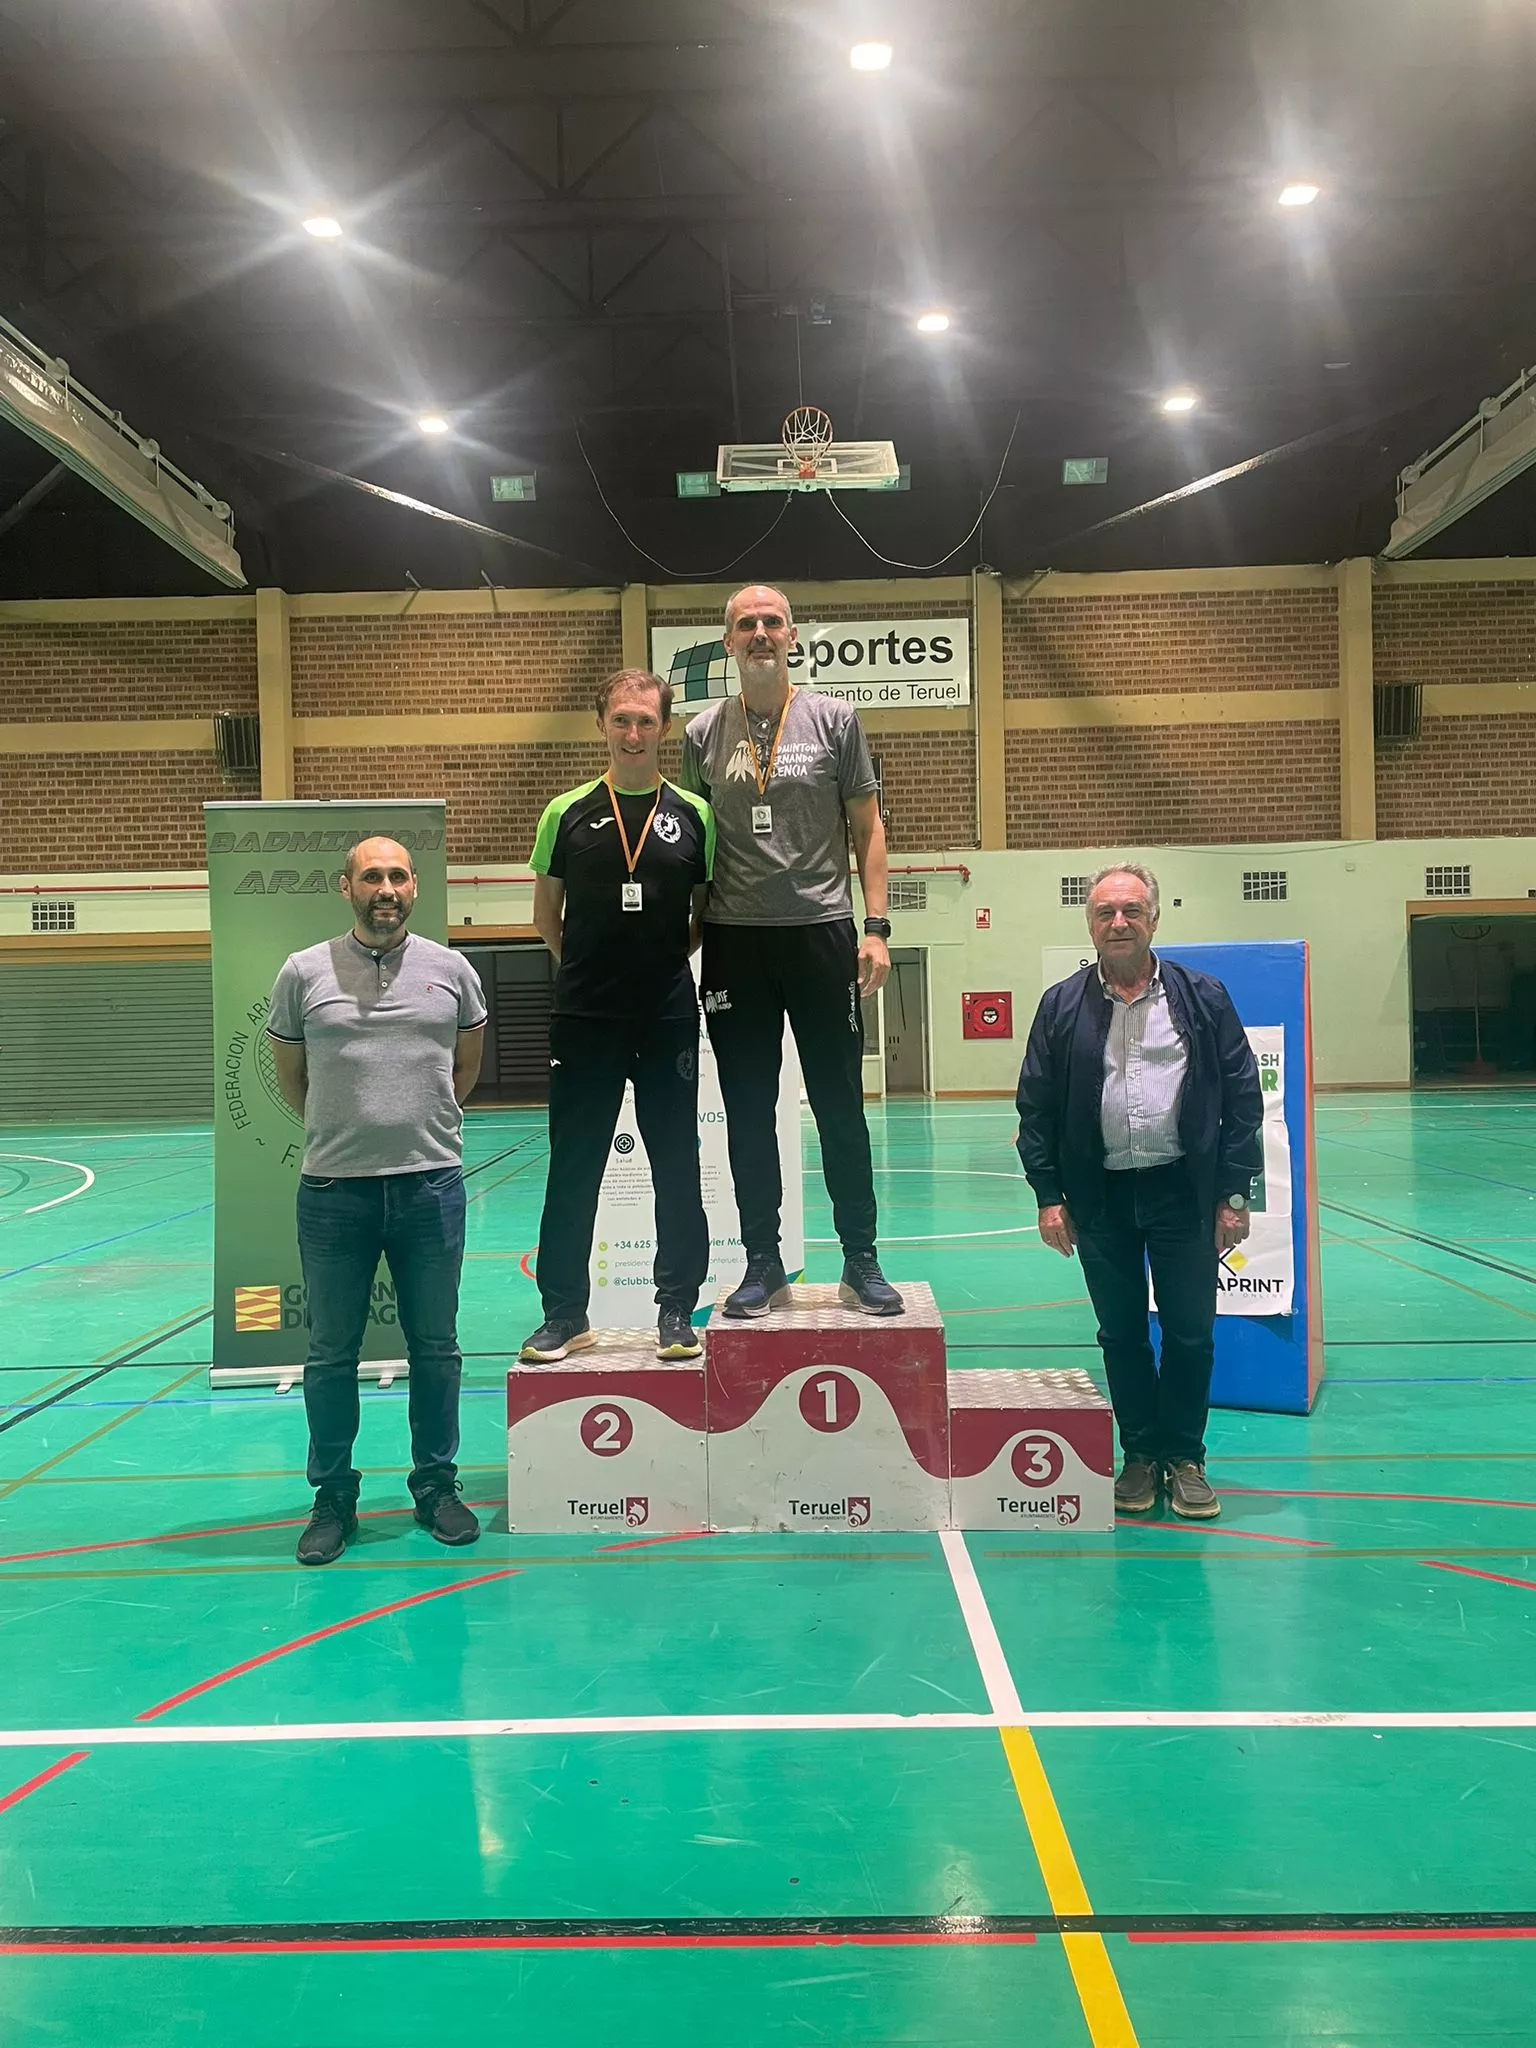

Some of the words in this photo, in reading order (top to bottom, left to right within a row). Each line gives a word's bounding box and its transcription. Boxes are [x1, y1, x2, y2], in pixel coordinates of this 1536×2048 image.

[879, 685, 900, 700] de
[907, 683, 961, 700] Teruel
[208, 829, 444, 854] BADMINON
[224, 1030, 252, 1131] FEDERACION
[613, 1240, 632, 1249] +34
[634, 1239, 651, 1249] 625
[816, 1379, 838, 1424] 1
[592, 1411, 621, 1450] 2
[1024, 1443, 1052, 1481] 3
[567, 1498, 624, 1515] Teruel
[788, 1498, 846, 1515] Teruel
[997, 1496, 1055, 1513] Teruel
